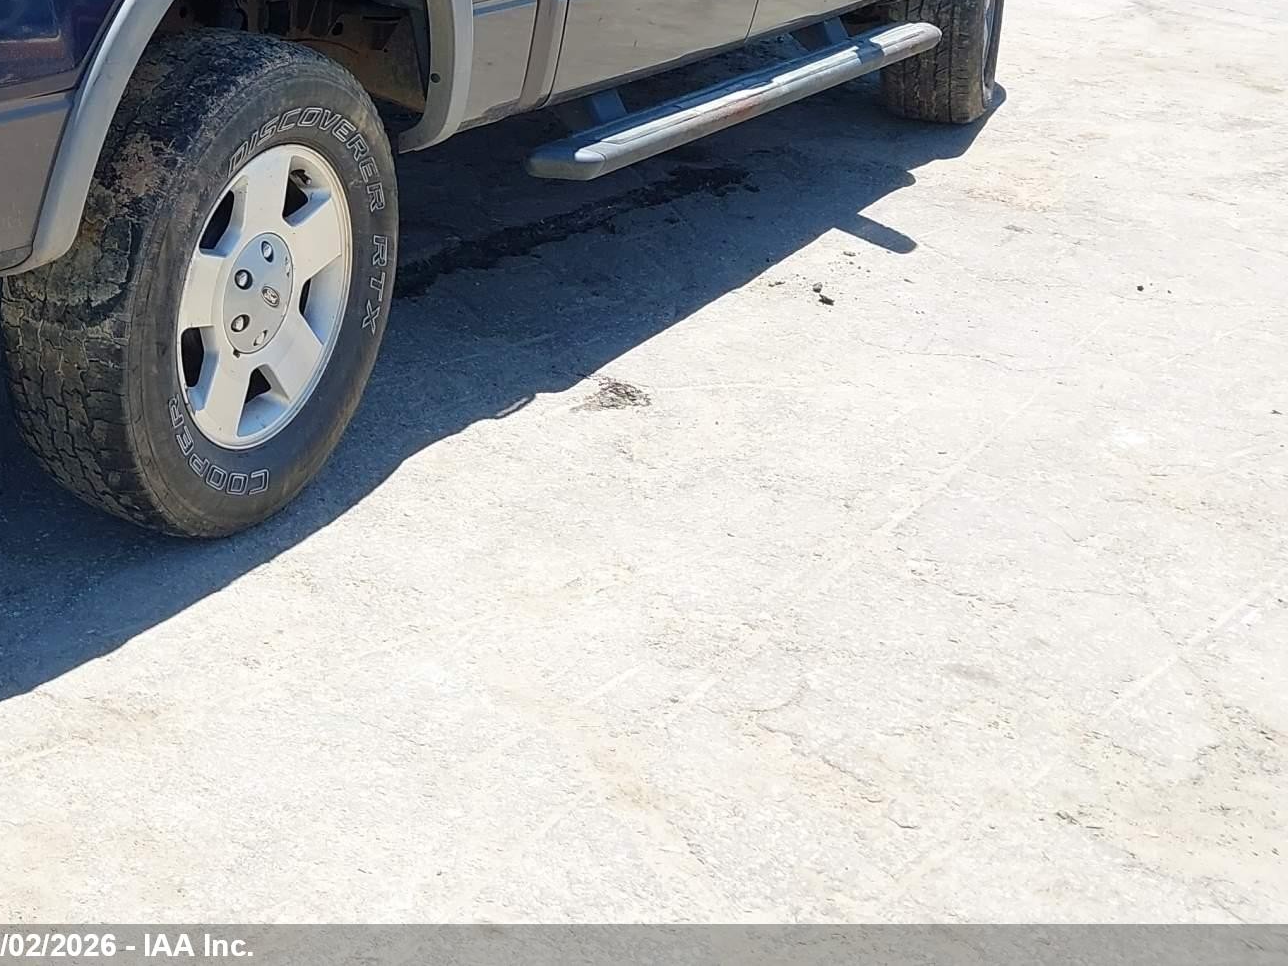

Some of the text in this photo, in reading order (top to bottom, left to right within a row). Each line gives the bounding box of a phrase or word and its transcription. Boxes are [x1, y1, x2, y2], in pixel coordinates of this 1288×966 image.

[227, 107, 389, 335] DISCOVERER RTX
[168, 394, 270, 497] COOPER
